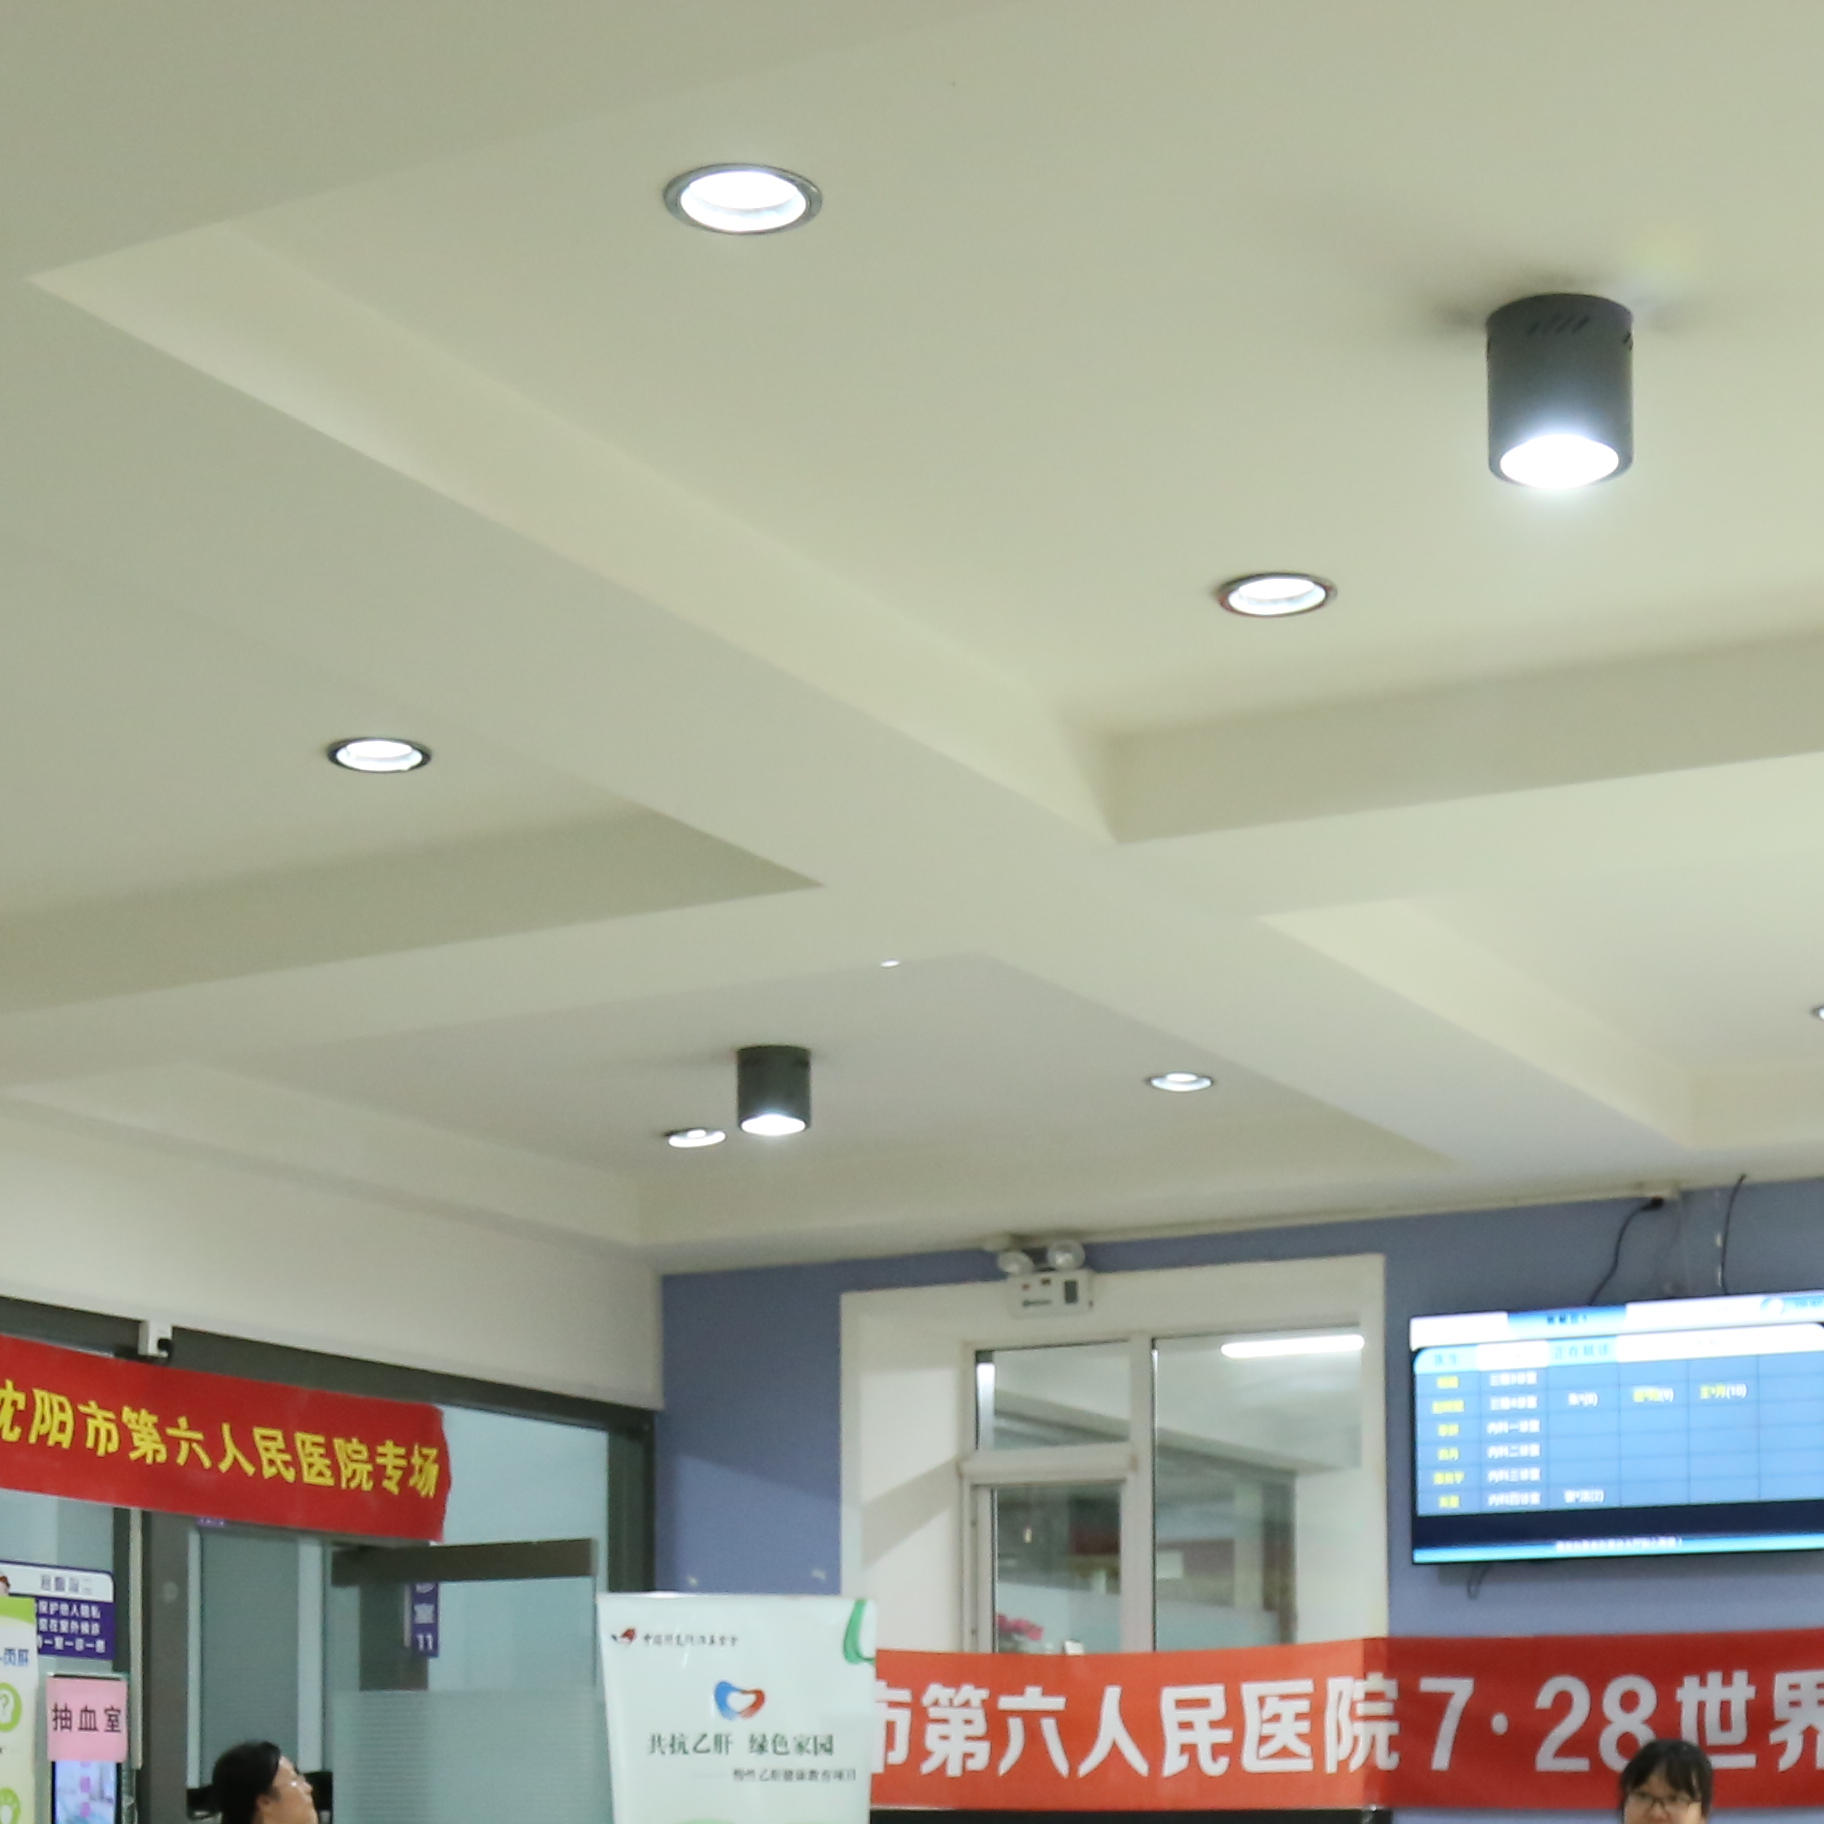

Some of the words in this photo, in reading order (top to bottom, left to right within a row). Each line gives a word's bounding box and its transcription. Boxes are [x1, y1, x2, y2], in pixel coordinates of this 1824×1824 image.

[51, 1702, 123, 1735] 抽血室
[648, 1732, 733, 1756] 共抗乙肝
[748, 1733, 836, 1757] 绿色家园
